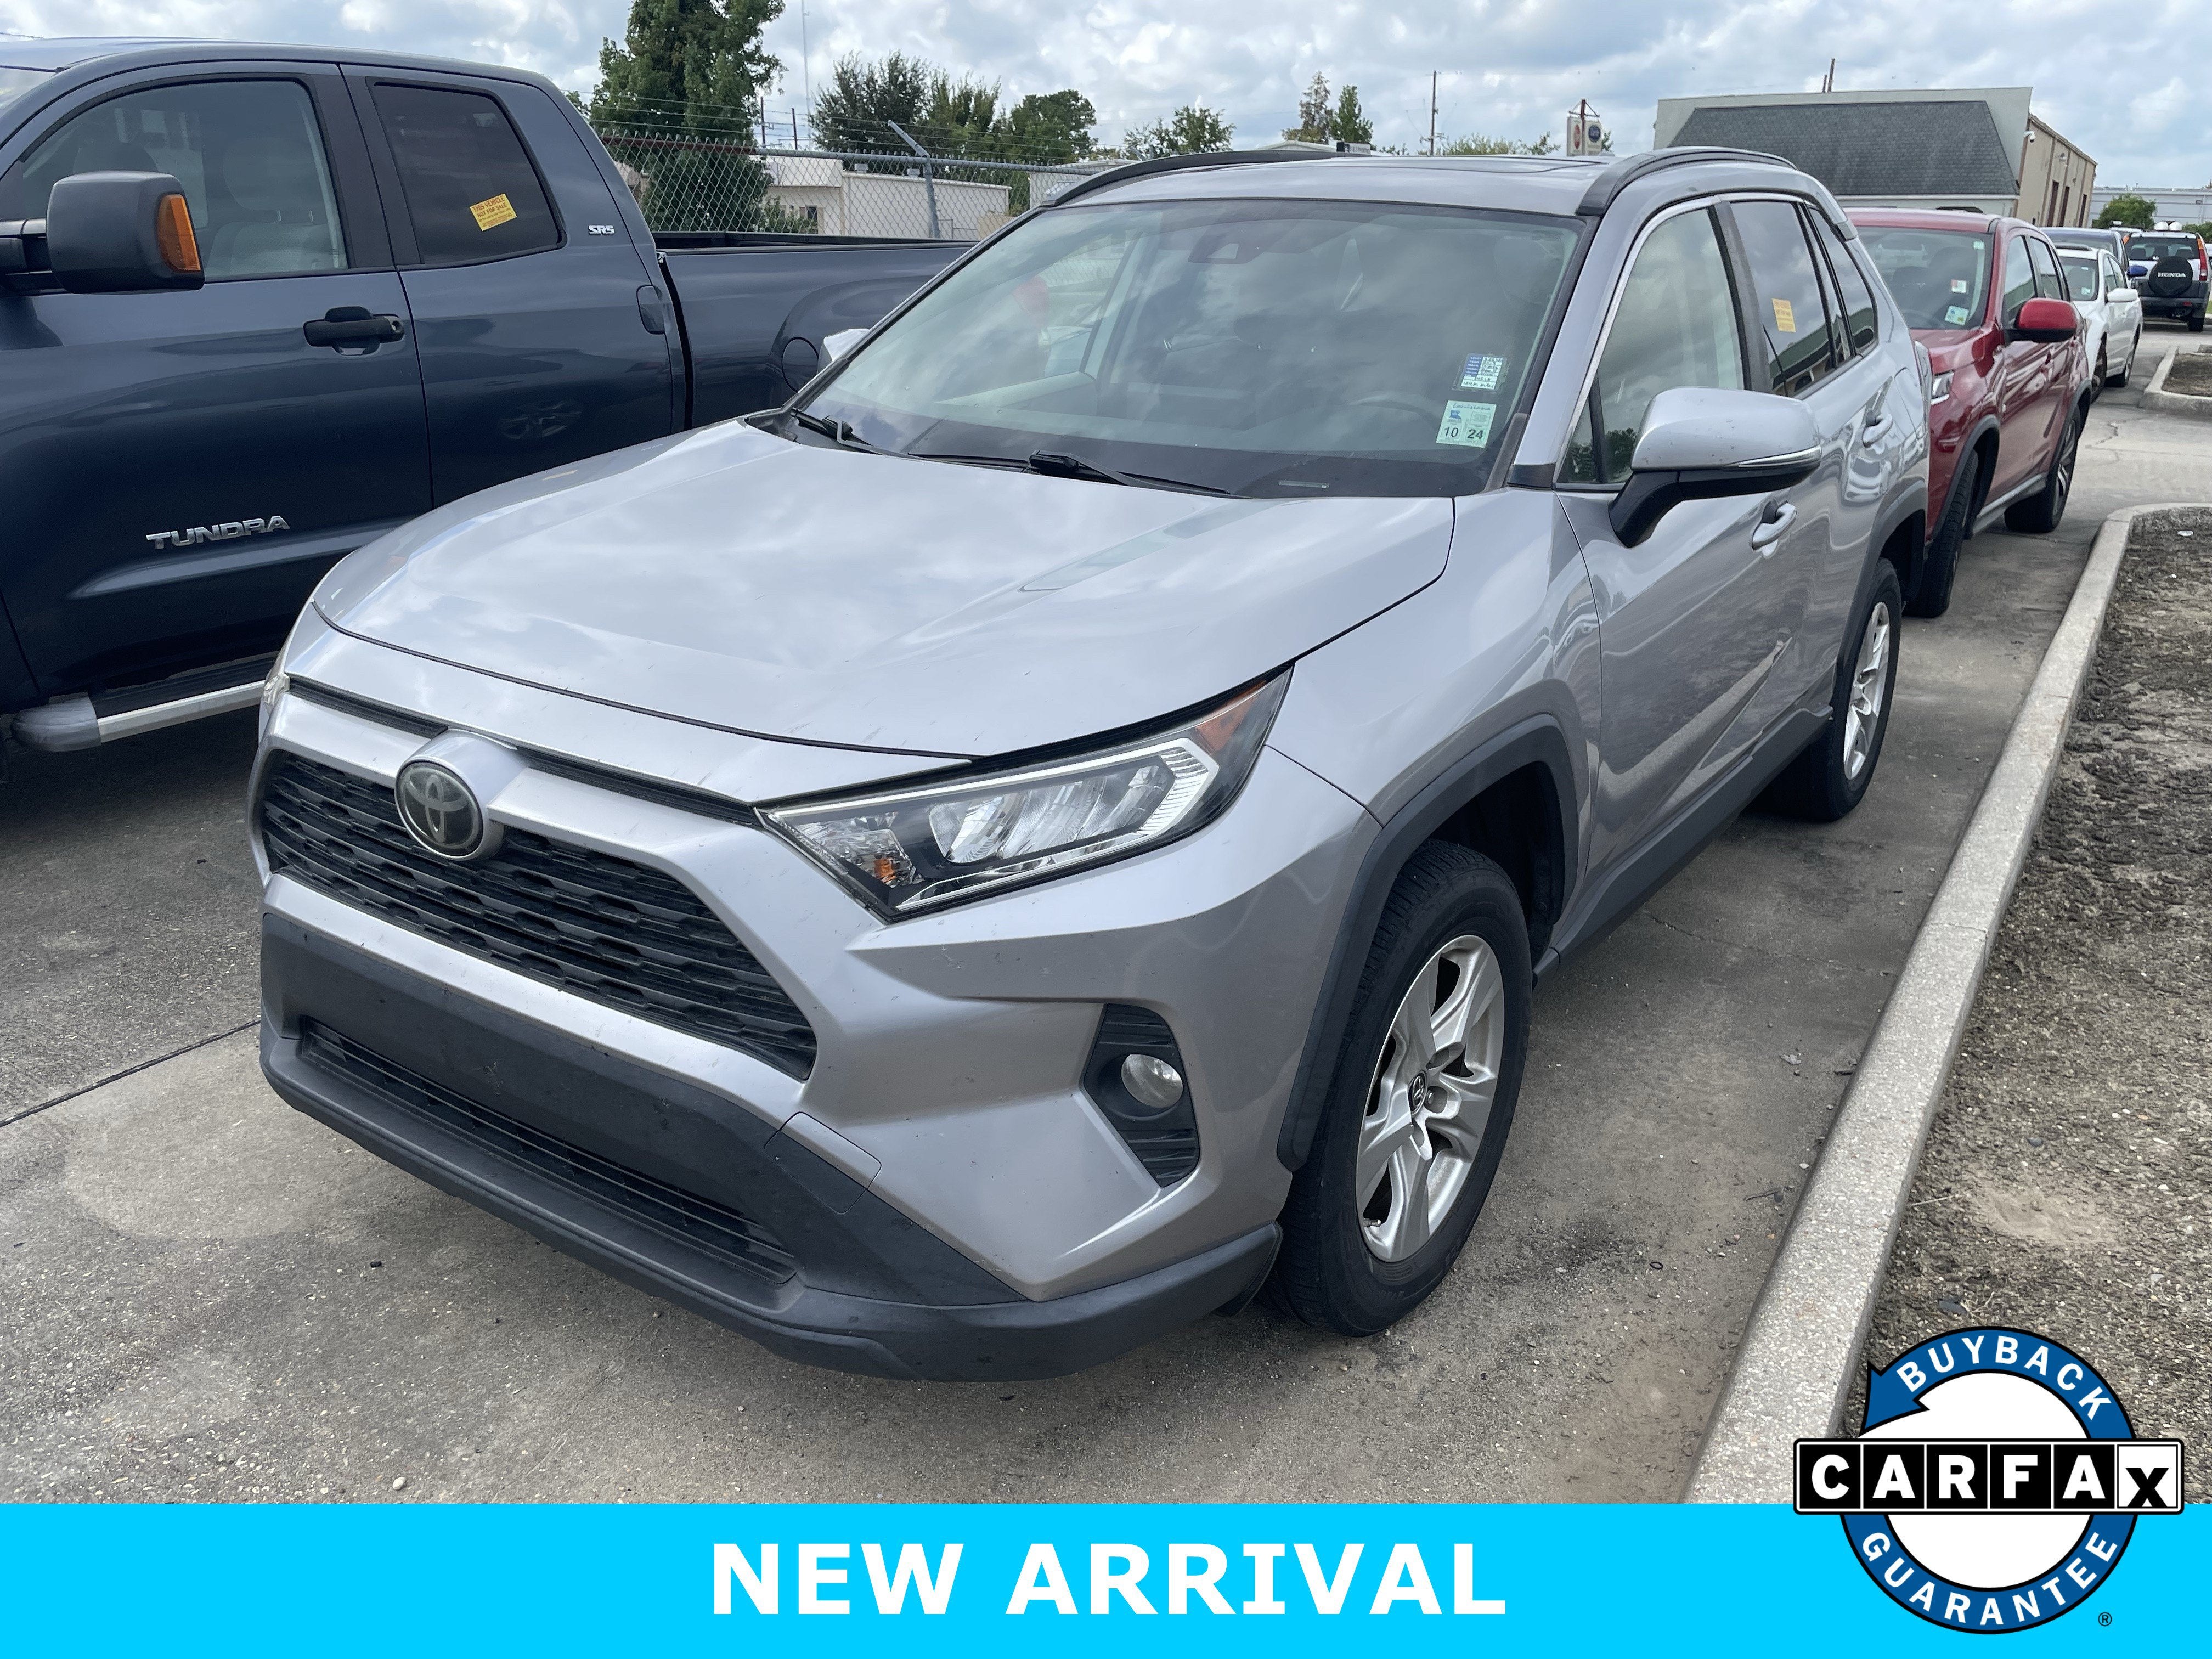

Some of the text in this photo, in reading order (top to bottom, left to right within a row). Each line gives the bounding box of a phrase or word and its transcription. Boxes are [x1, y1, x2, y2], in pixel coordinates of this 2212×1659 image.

[472, 195, 506, 212] THIS VEHICLE
[588, 225, 615, 235] SR5
[1444, 427, 1483, 439] 10 24
[146, 515, 290, 549] TUNDRA
